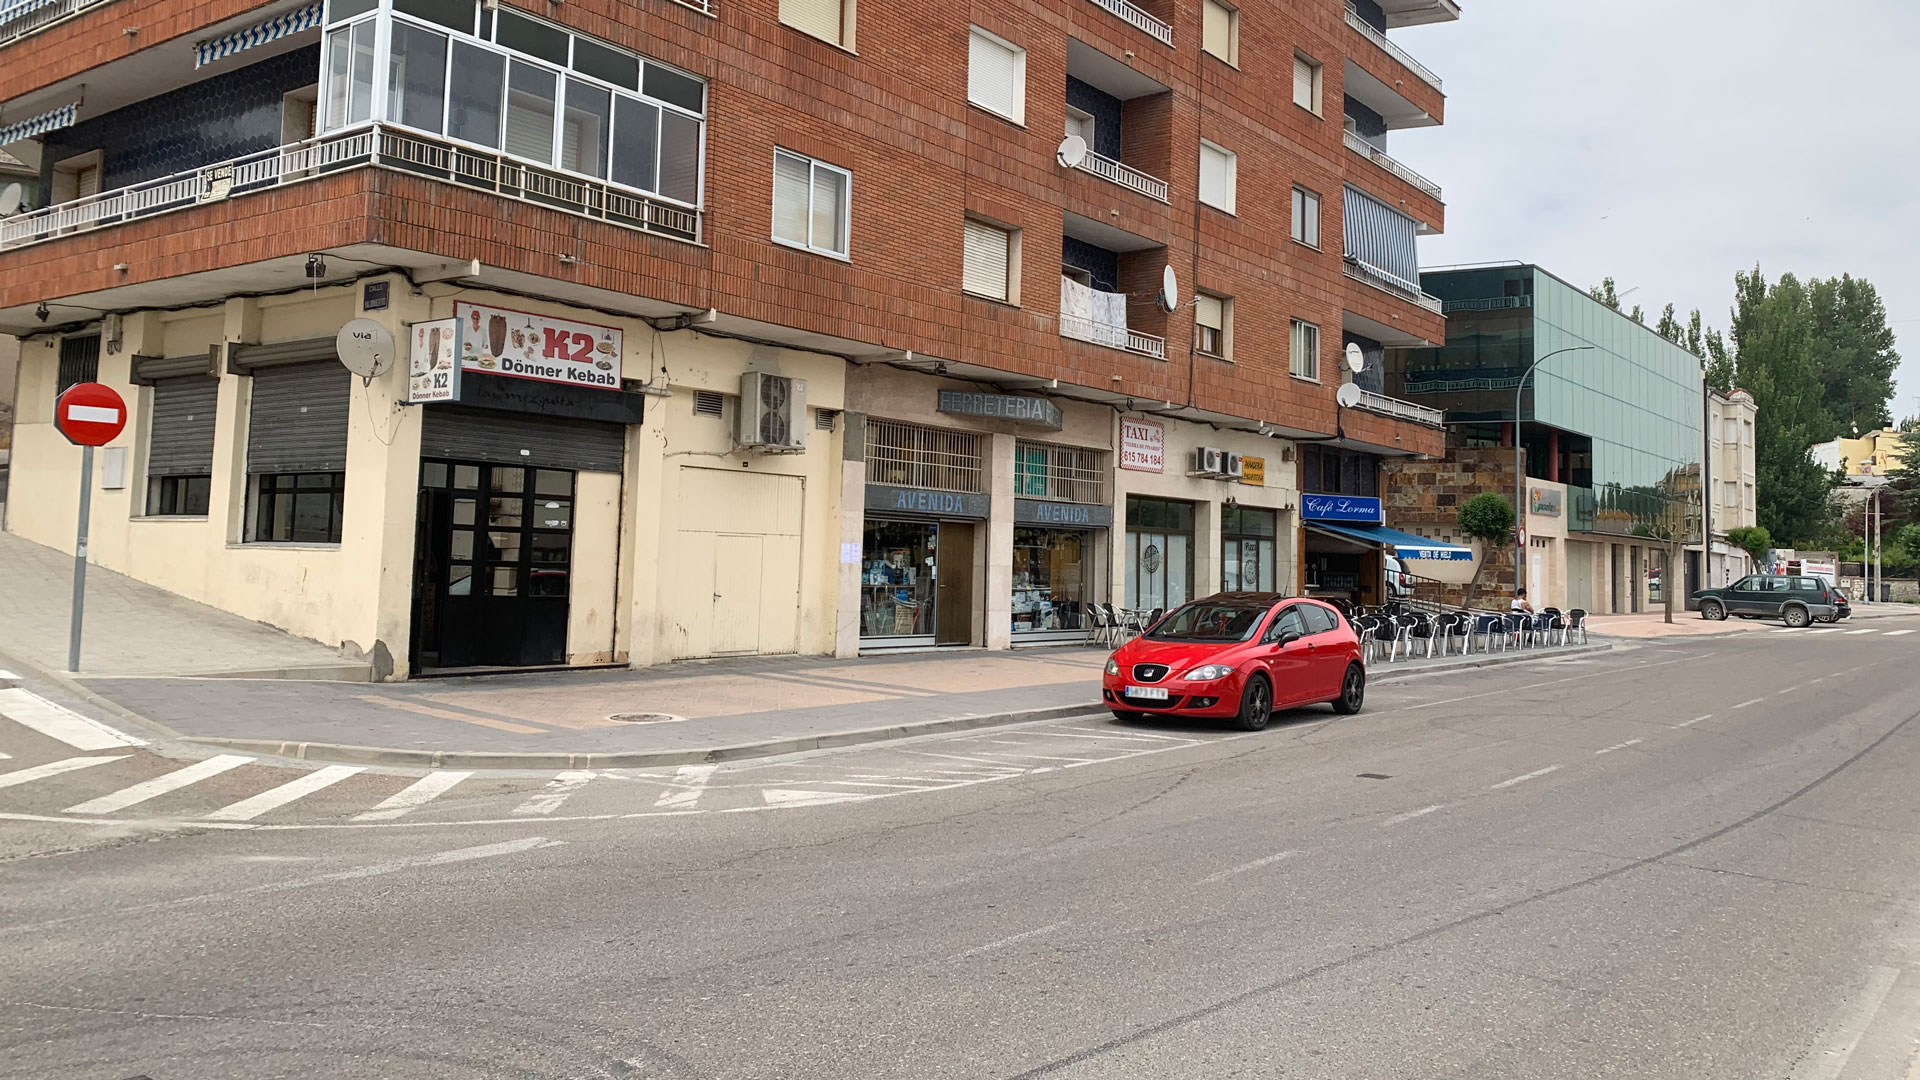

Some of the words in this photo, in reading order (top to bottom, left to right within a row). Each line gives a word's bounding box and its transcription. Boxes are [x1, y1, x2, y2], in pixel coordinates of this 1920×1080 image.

[207, 171, 213, 181] SE
[214, 166, 232, 179] VENDE
[542, 327, 594, 364] K2
[433, 372, 448, 389] K2
[502, 357, 563, 378] Dönner
[567, 366, 616, 386] Kebab
[412, 392, 432, 400] Dönner
[432, 390, 450, 399] Kebab
[940, 390, 1043, 419] FERRETERIA
[1124, 425, 1148, 441] TAXI
[1124, 451, 1136, 462] 615
[1137, 453, 1148, 463] 784
[1150, 454, 1161, 465] 184
[897, 492, 963, 513] AVENIDA
[1306, 497, 1334, 517] Café
[1336, 499, 1375, 514] Lorma
[1036, 503, 1089, 523] AVENIDA
[1419, 550, 1431, 558] VENTA
[1432, 550, 1439, 558] DE
[1440, 551, 1451, 559] HIELO
